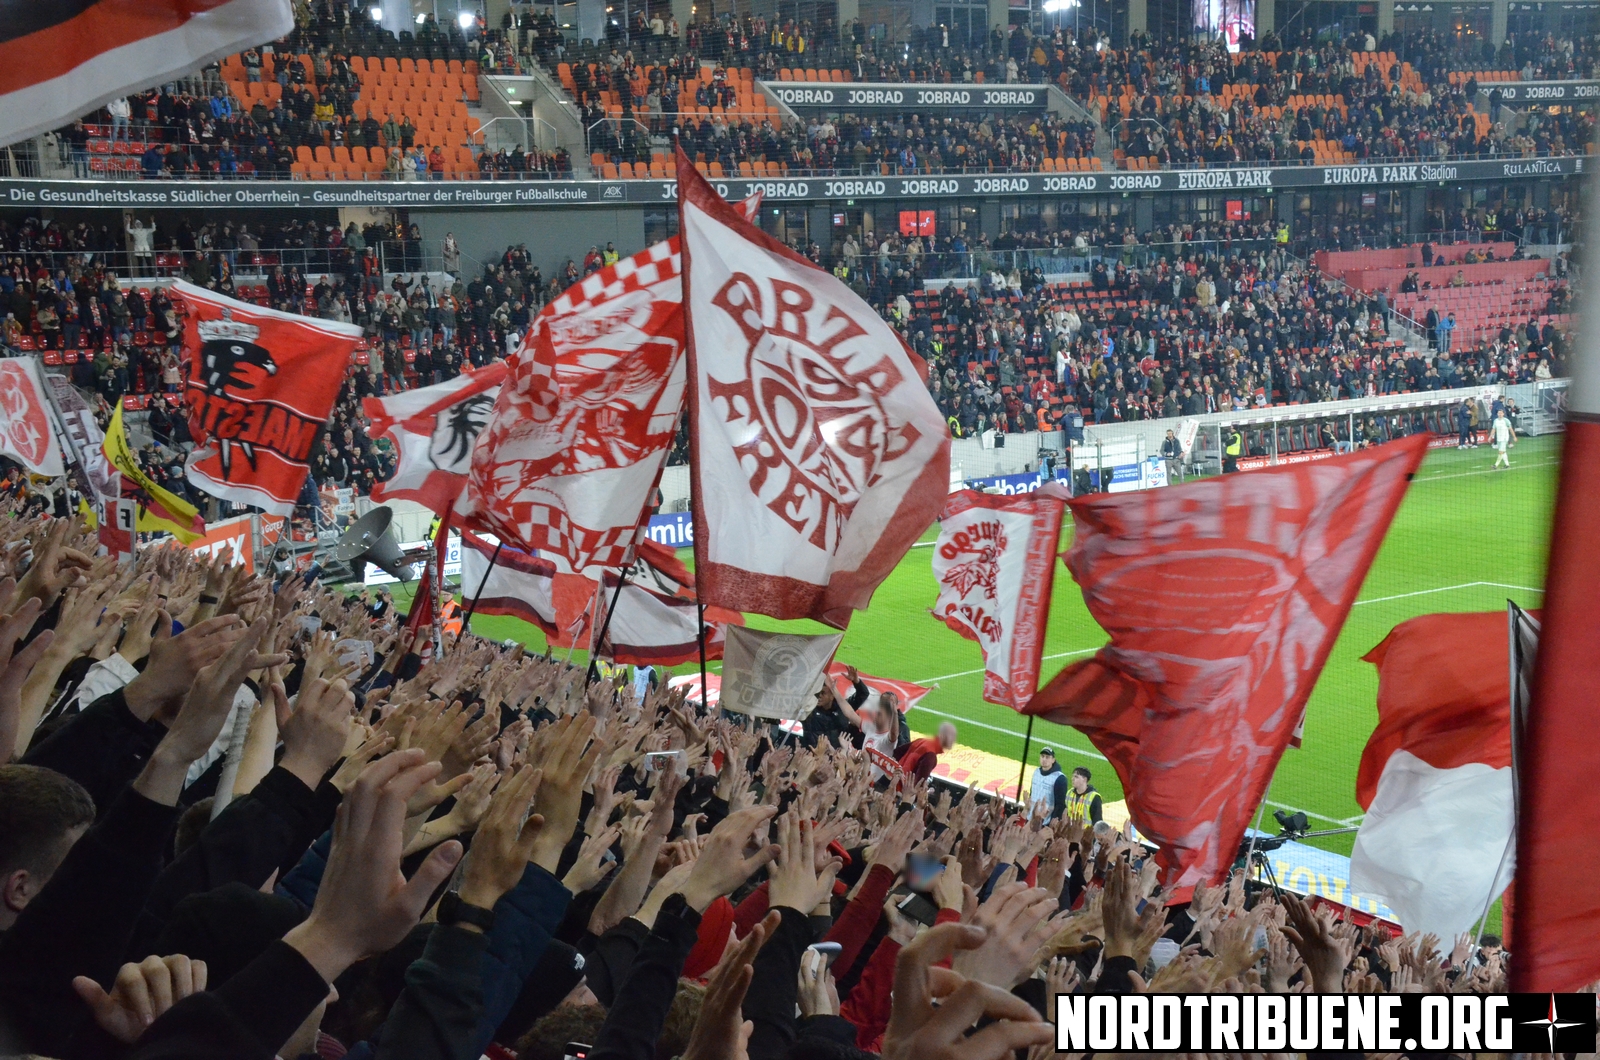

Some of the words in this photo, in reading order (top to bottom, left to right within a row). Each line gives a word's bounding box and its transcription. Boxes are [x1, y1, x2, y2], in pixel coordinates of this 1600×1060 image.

[777, 89, 833, 103] JOBRAD
[848, 90, 903, 104] JOBRAD
[917, 91, 970, 104] JOBRAD
[983, 91, 1034, 105] JOBRAD
[1525, 87, 1565, 98] JOBRAD
[1574, 86, 1600, 97] JOBR
[1323, 166, 1378, 184] EUROPA
[1382, 165, 1418, 182] PARK
[1420, 164, 1457, 181] Stadion
[1503, 159, 1562, 176] RULANTICA
[973, 177, 1029, 193] JOBRAD
[1043, 177, 1097, 192] JOBRAD
[1109, 175, 1162, 190] JOBRAD
[1178, 171, 1233, 189] EUROPA
[1236, 169, 1272, 187] PARK
[745, 182, 809, 198] JOBRAD
[824, 181, 885, 196] JOBRAD
[901, 180, 959, 195] JOBRAD
[10, 188, 36, 201] Die
[39, 188, 167, 203] Gesundheitskasse
[170, 189, 232, 203] Südlicher
[235, 190, 300, 203] Oberrhein
[313, 190, 431, 204] Gesundheitspartner
[433, 189, 453, 202] der
[455, 189, 513, 203] Freiburger
[515, 188, 588, 200] Fußballschule
[1288, 456, 1310, 464] JOBRAD
